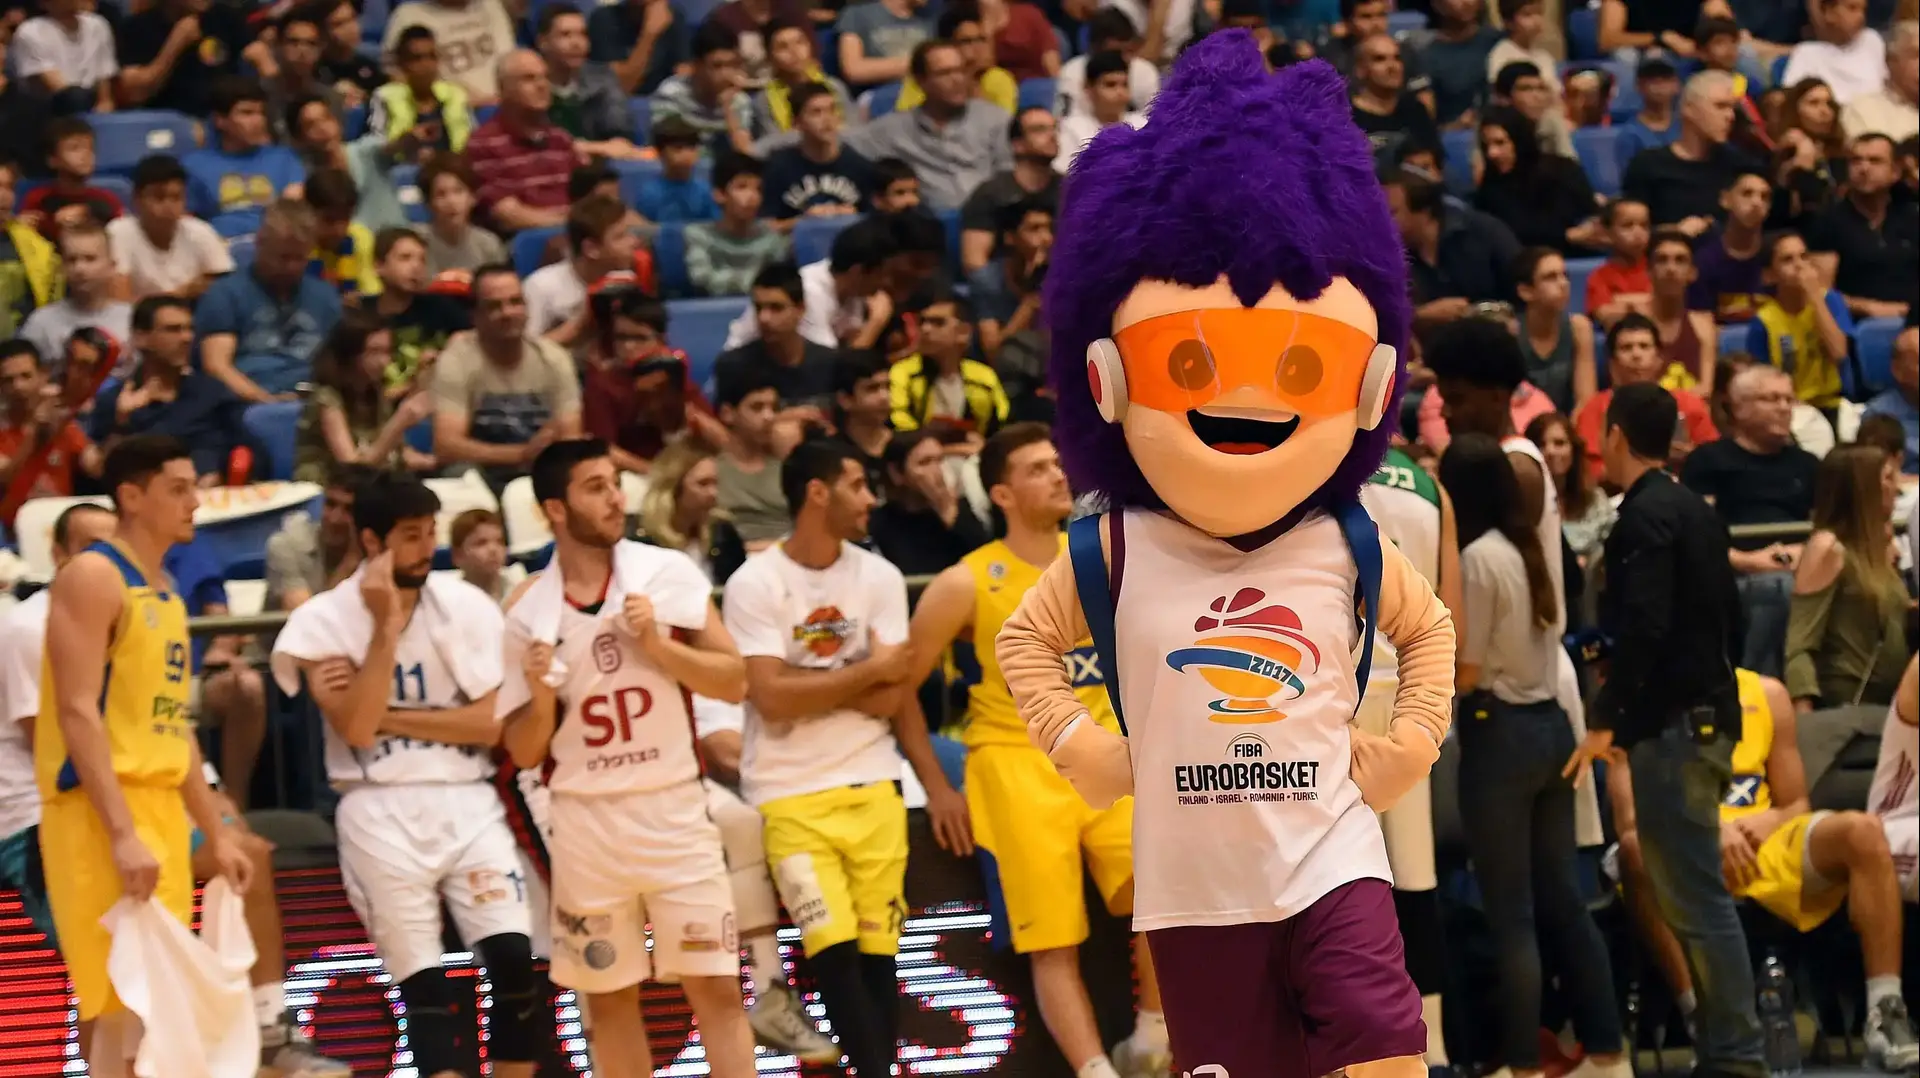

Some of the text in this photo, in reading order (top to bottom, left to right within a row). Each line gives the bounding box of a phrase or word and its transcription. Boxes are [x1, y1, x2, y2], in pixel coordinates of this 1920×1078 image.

[164, 640, 186, 683] 9
[592, 632, 622, 675] 6
[1249, 655, 1292, 683] 2017
[580, 686, 653, 748] SP
[1234, 743, 1263, 758] FIBA
[1174, 761, 1320, 792] EUROBASKET
[1178, 791, 1319, 805] FINLAND ISRAEL ROMANIA TURKEY
